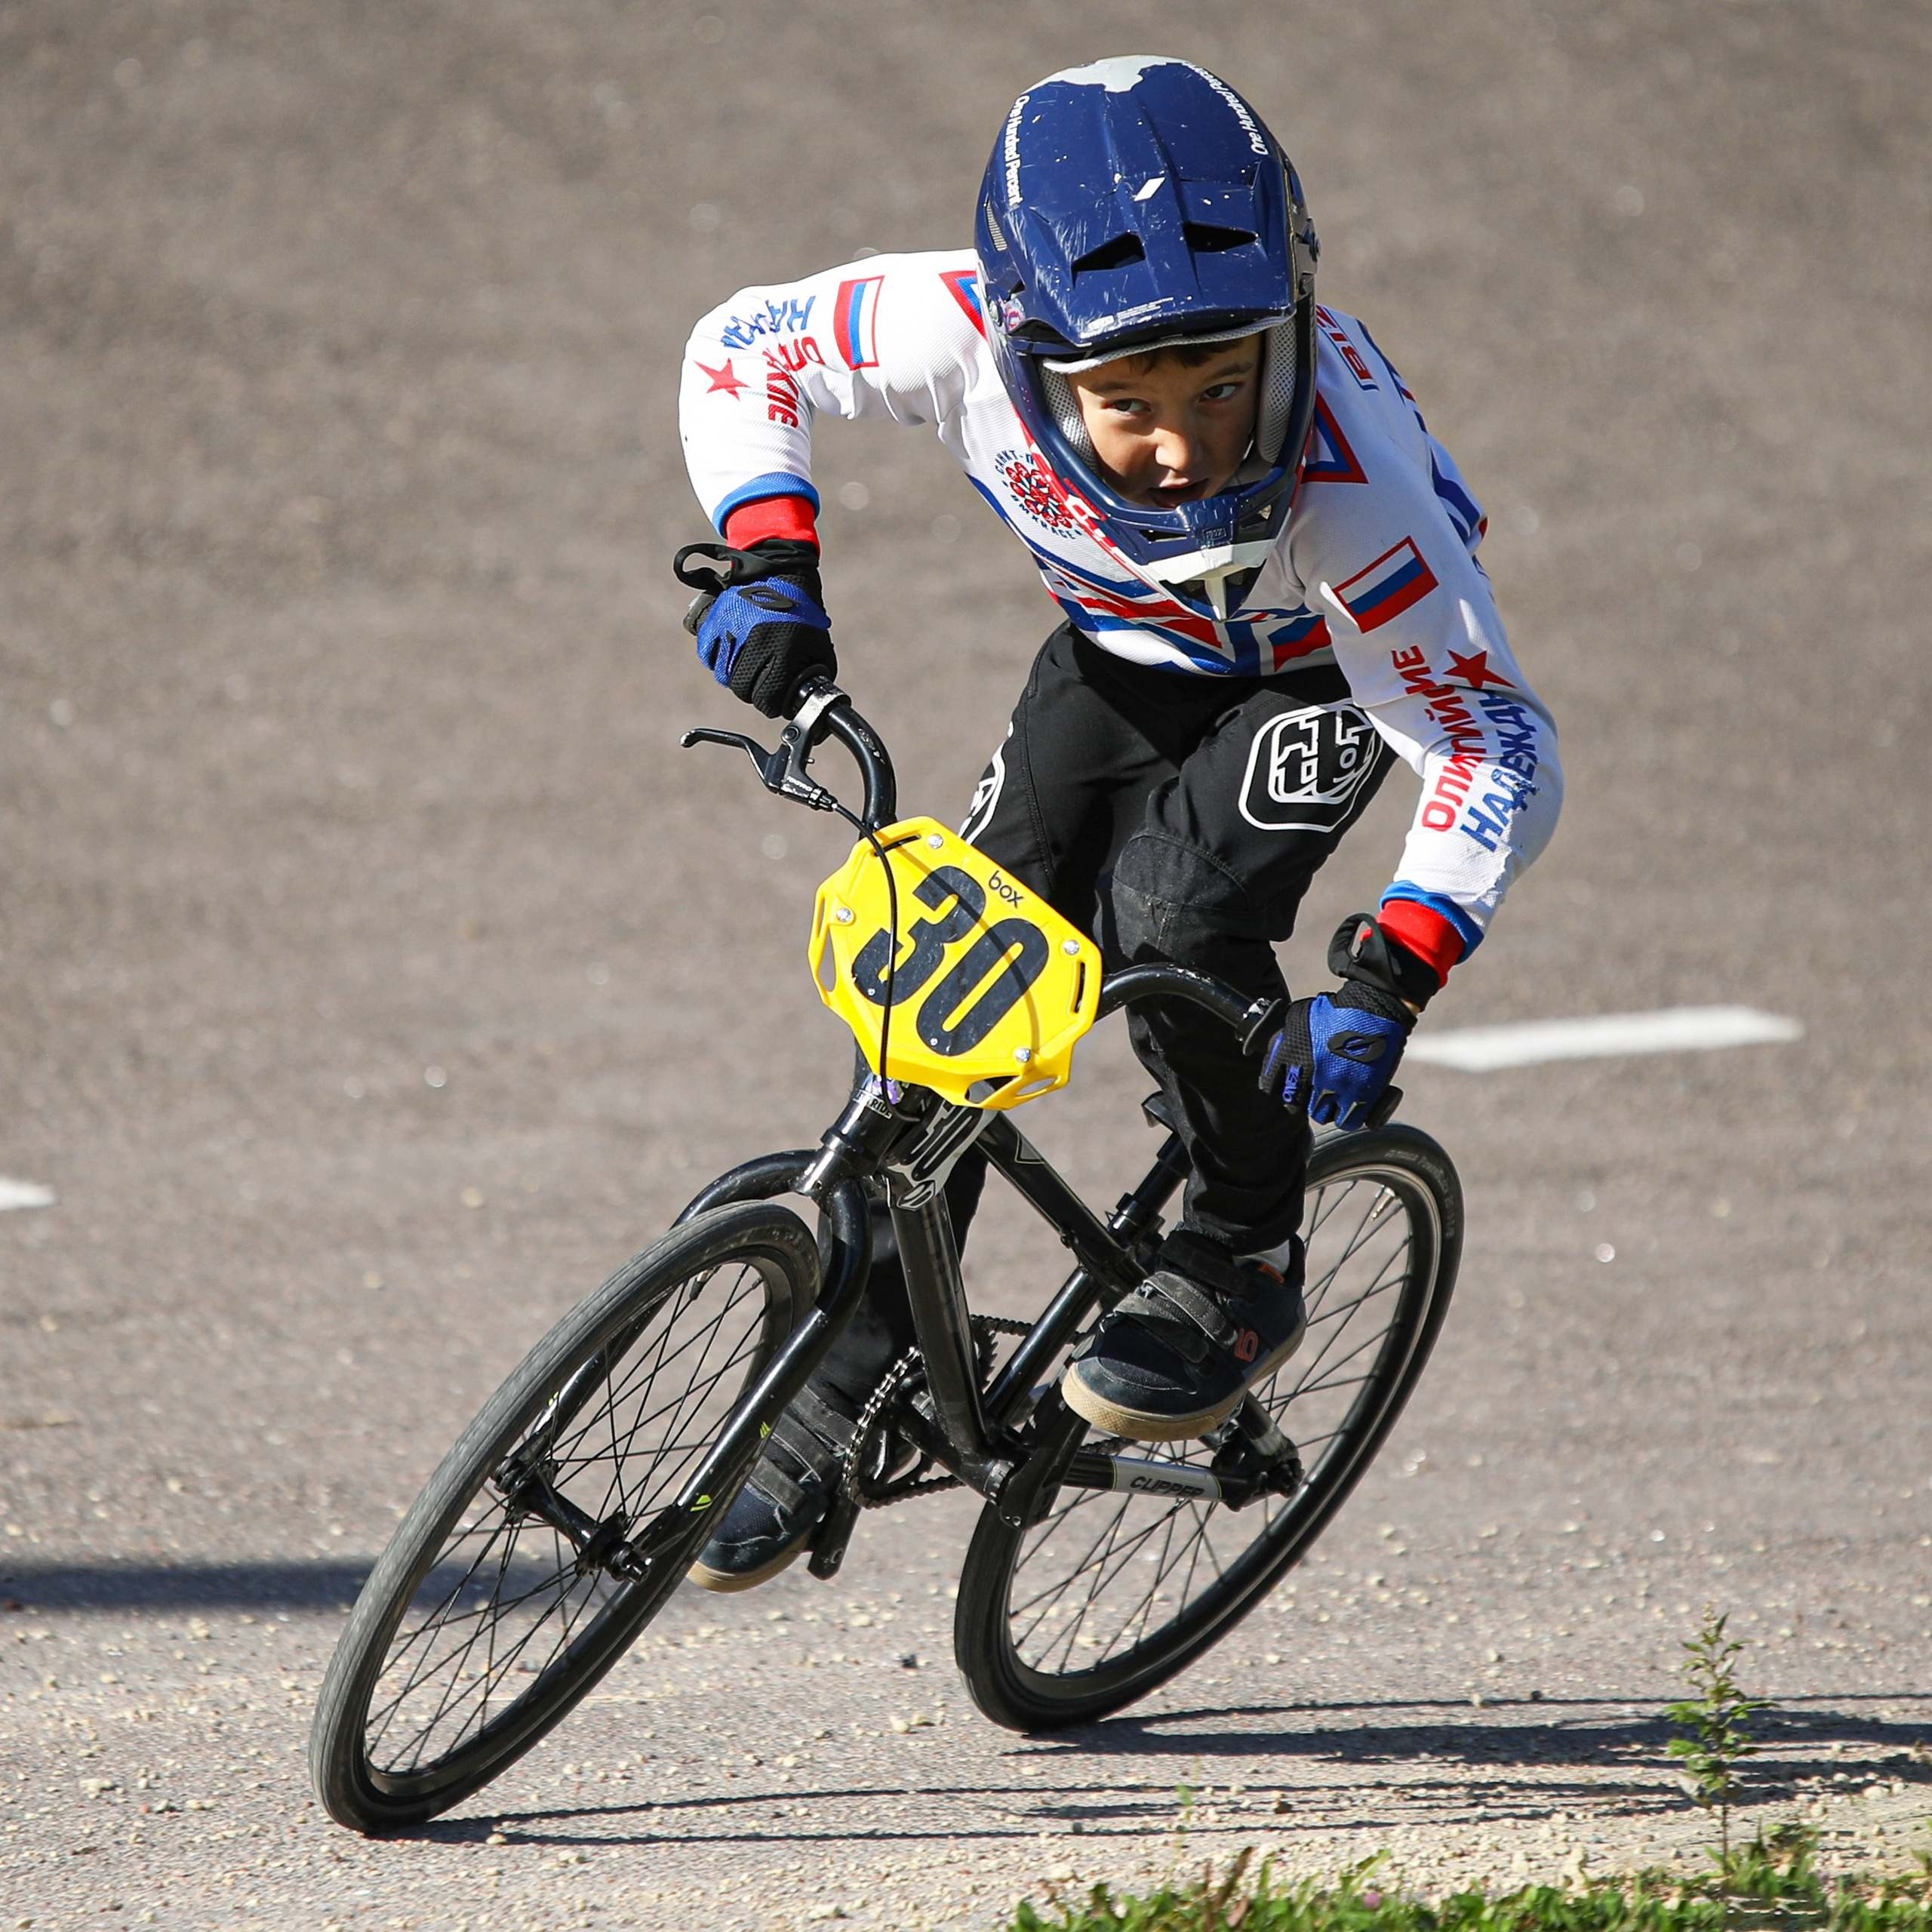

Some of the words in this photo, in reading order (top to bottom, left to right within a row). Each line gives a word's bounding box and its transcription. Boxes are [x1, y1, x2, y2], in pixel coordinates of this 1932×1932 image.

[1010, 95, 1030, 118] One
[1217, 90, 1259, 132] Hundred
[1004, 115, 1023, 162] Hundred
[1248, 131, 1269, 155] One
[1005, 158, 1024, 207] Percent
[988, 871, 1024, 907] box
[851, 865, 1050, 1057] 30
[1130, 1475, 1205, 1498] CLIPPER
